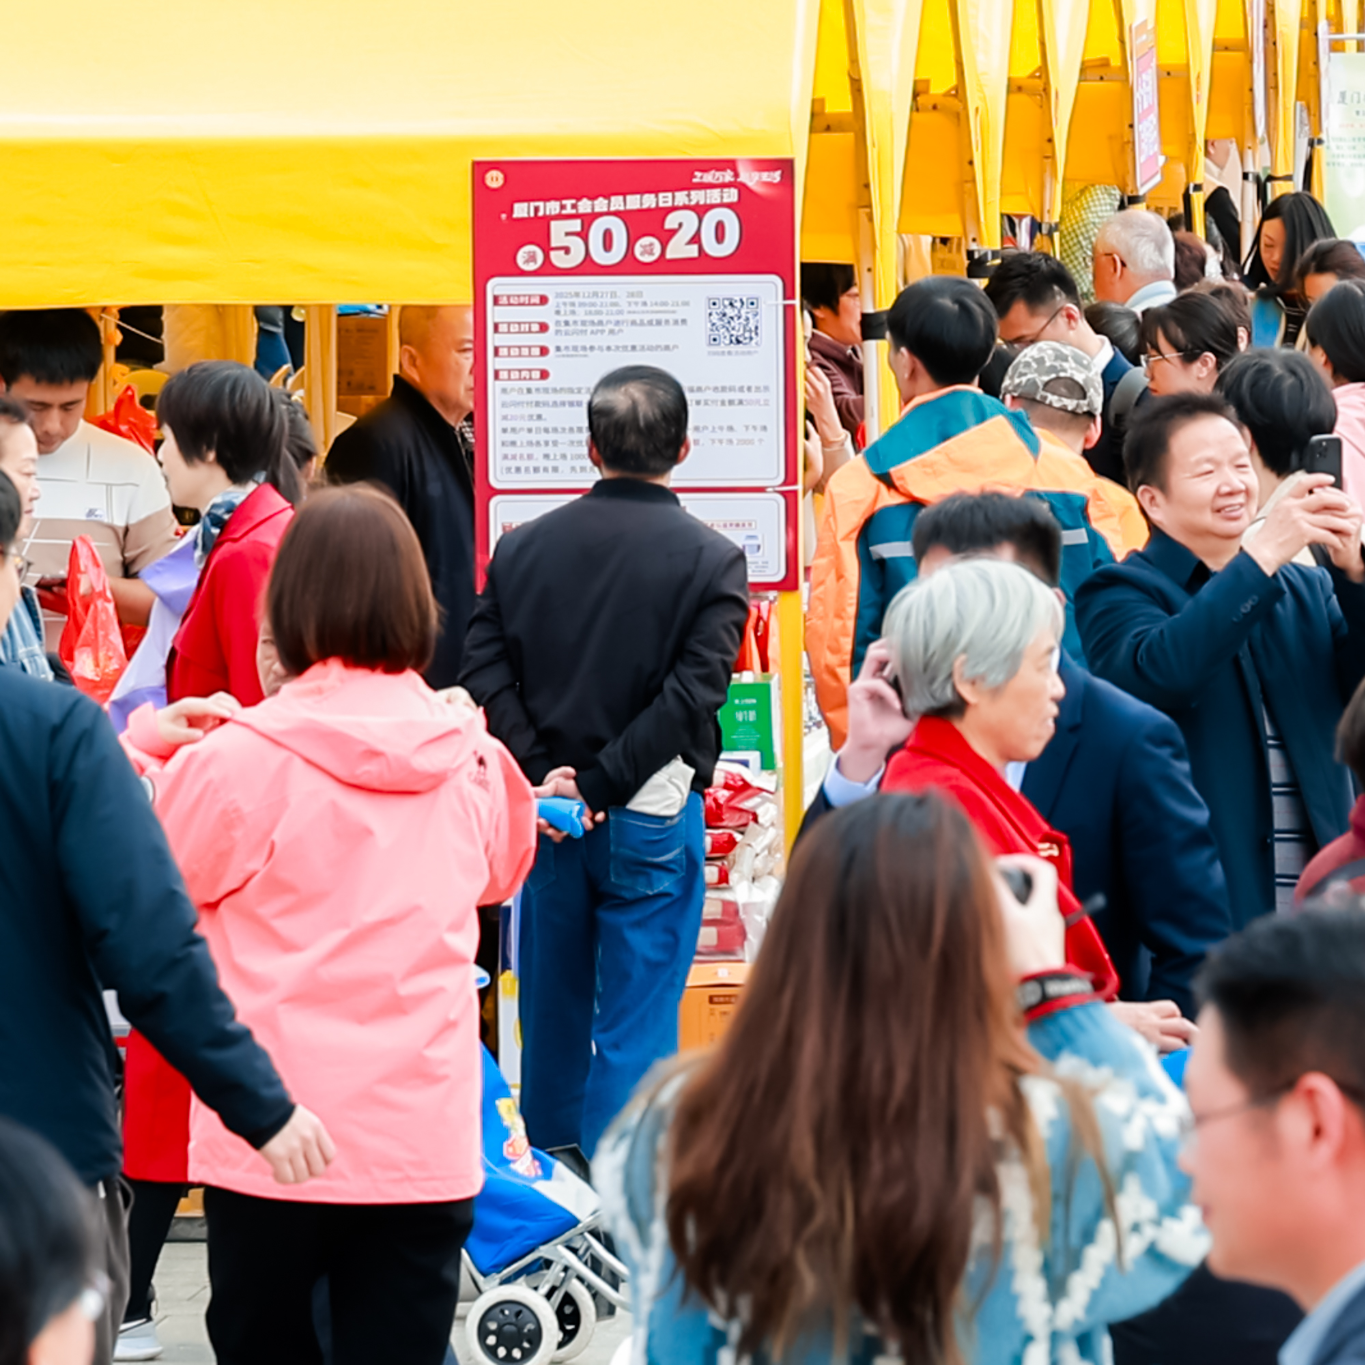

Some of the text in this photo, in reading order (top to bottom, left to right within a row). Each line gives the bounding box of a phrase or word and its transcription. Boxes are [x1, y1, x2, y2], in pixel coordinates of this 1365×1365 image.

[511, 187, 740, 219] 厦门市工会会员服务日系列活动
